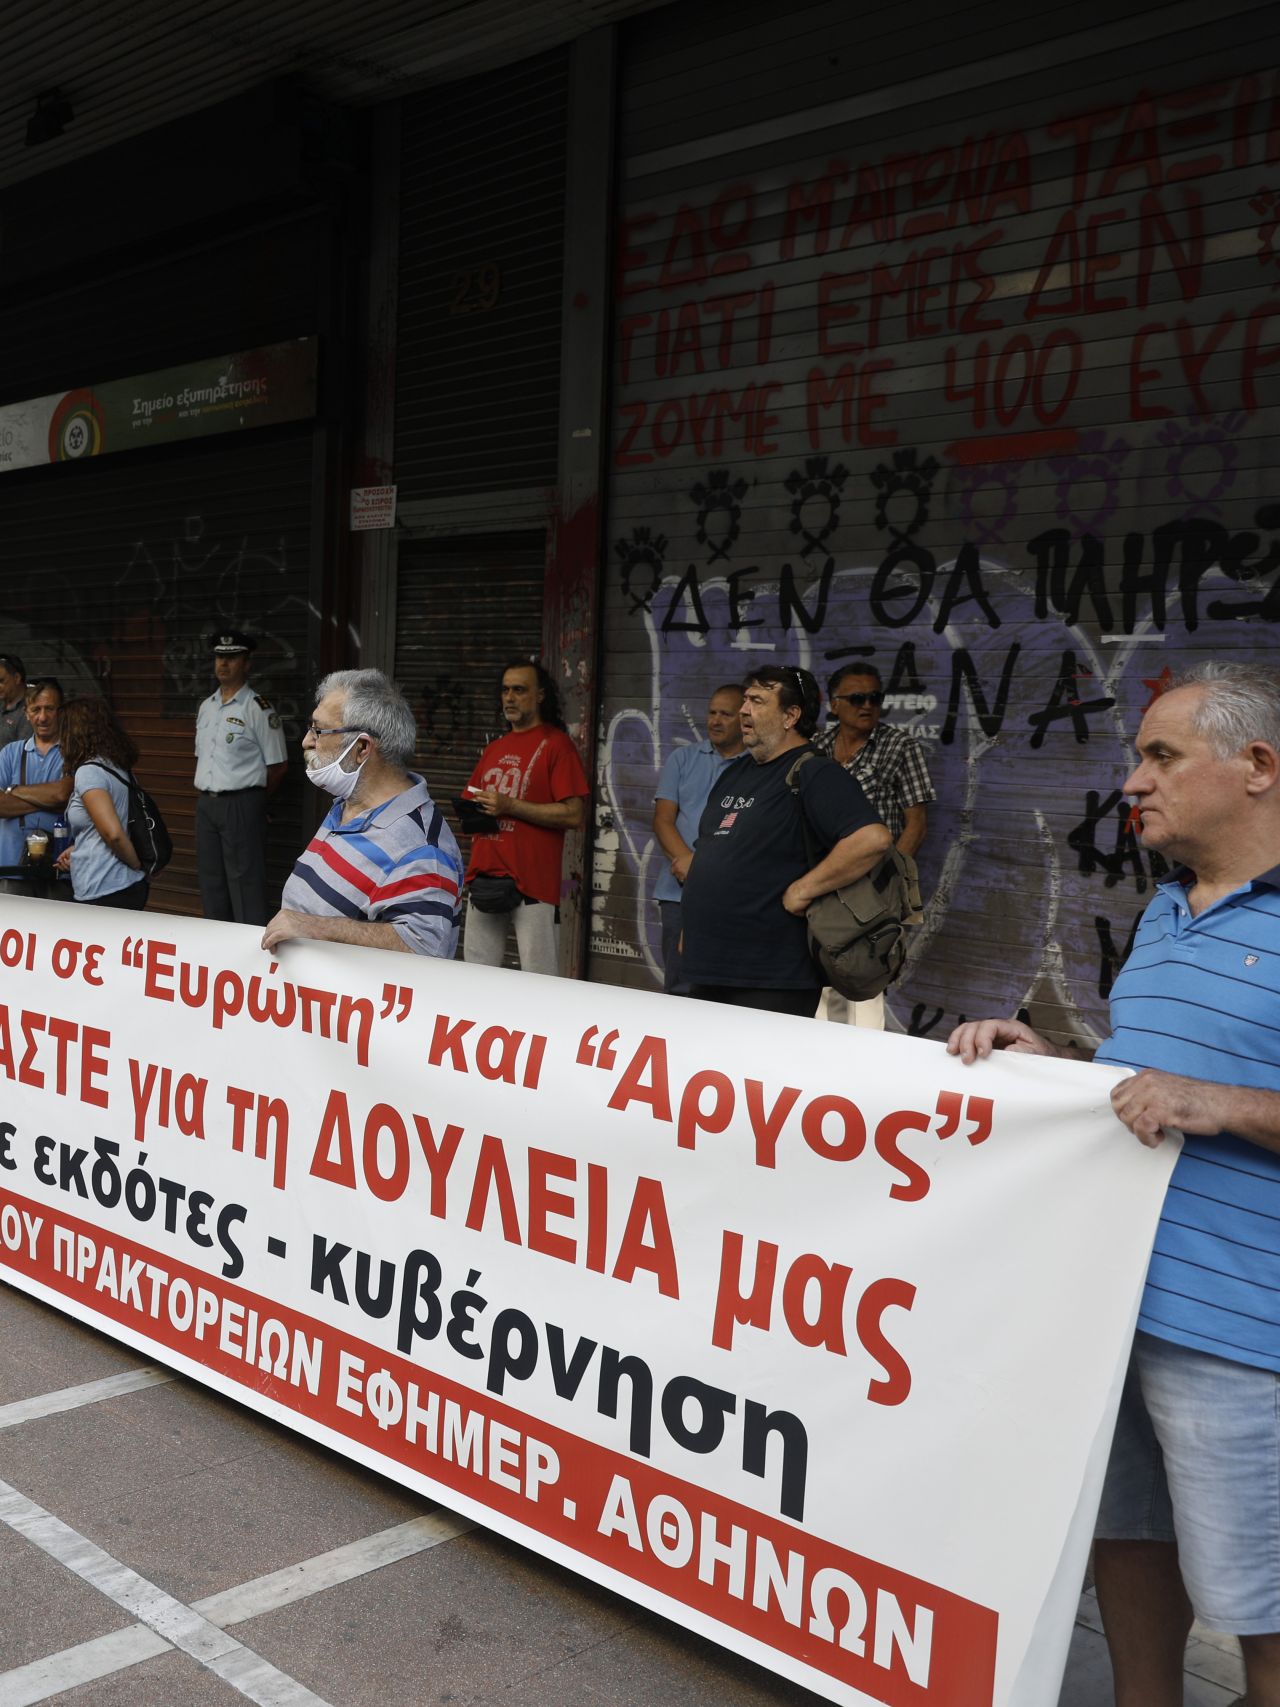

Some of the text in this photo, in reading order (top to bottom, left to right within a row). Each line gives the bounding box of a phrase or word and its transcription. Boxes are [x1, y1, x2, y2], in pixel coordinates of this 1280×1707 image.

[819, 229, 1005, 358] ΕΜΕΙΣ
[1023, 188, 1205, 322] ΔΕΝ
[132, 392, 174, 417] Σημείο
[807, 358, 899, 450] ΜΕ
[943, 328, 1083, 430] 400
[661, 555, 835, 634] ΔΕΝ
[869, 541, 1002, 635] ΘΑ
[720, 795, 755, 810] USA
[51, 937, 105, 986] σε
[428, 1013, 547, 1091] και
[128, 1057, 208, 1143] για
[226, 1086, 289, 1191] τη
[309, 1089, 680, 1301] ΔΟΥΛΕΙΑ
[711, 1229, 917, 1407] μας
[34, 1136, 248, 1280] εκδότες
[267, 1236, 287, 1259] -
[310, 1233, 809, 1523] κυβέρνηση
[53, 1223, 324, 1397] ΠΡΑΚΤΟΡΕΙΩΝ
[336, 1349, 577, 1519] ΕΦΗΜΕΡ.
[597, 1473, 936, 1691] ΑΘΗΝΩΝ
